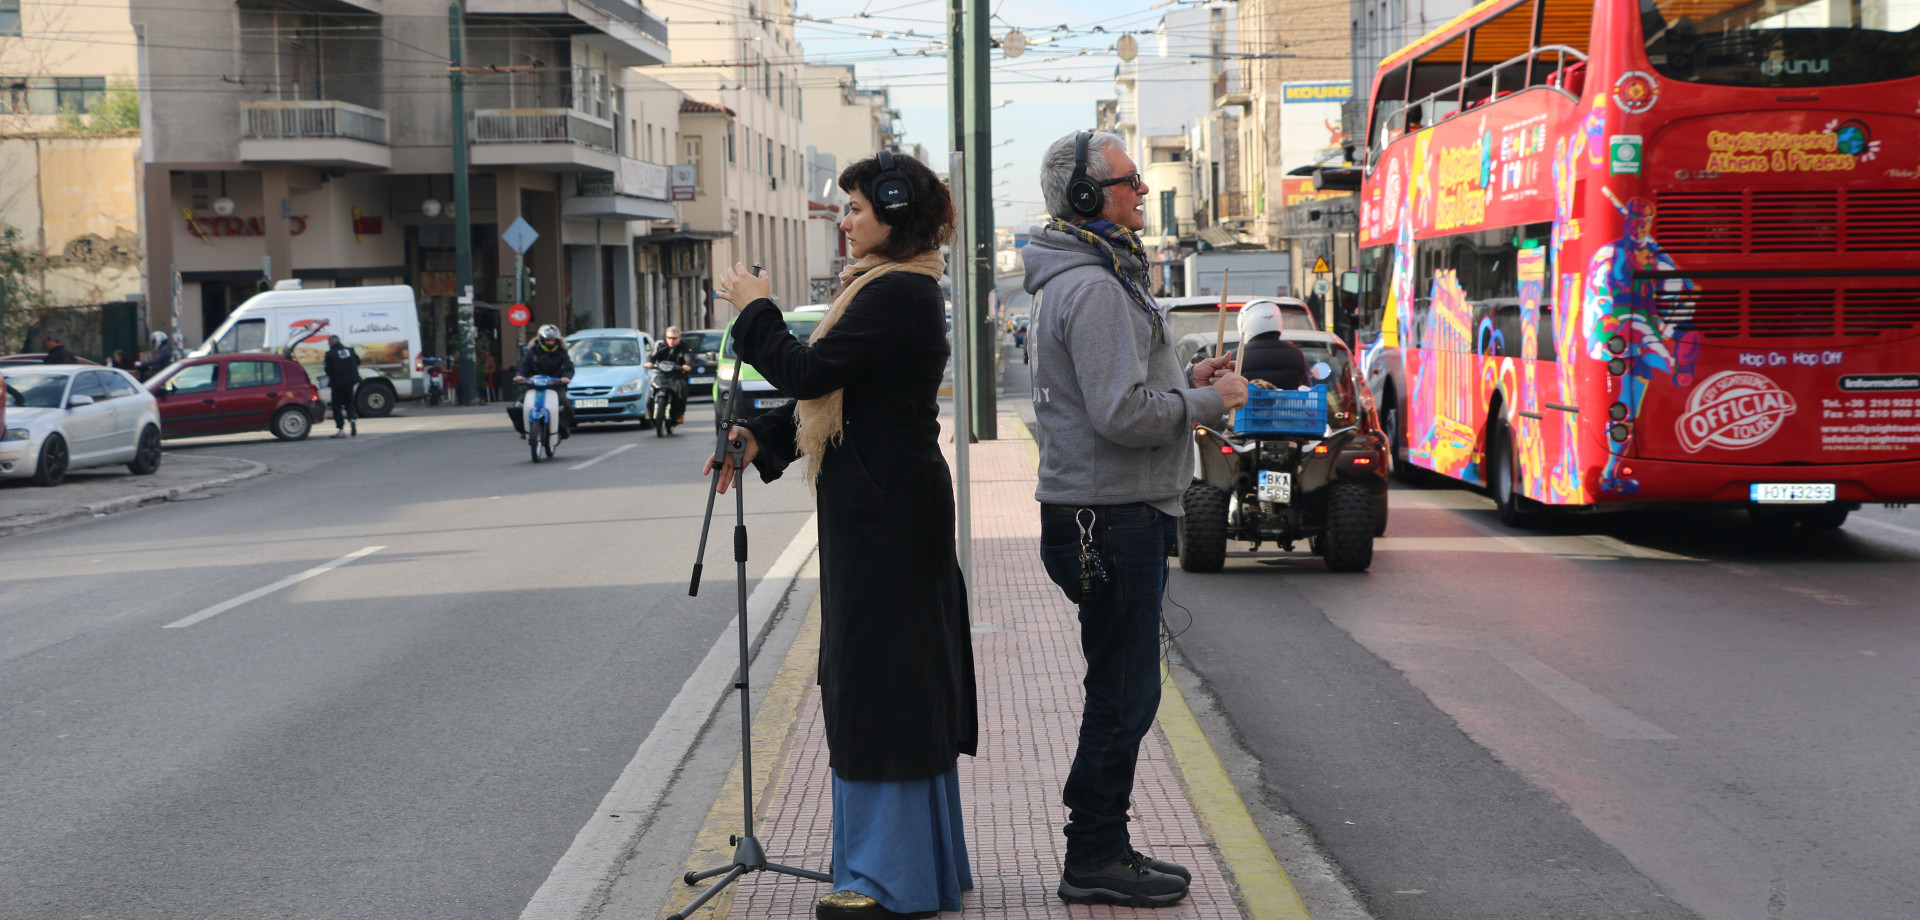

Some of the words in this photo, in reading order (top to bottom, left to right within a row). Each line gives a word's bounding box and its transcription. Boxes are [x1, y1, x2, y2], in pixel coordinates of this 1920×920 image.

[1706, 151, 1768, 172] Athens
[1770, 150, 1786, 172] &
[1786, 149, 1855, 171] Piraeus
[1738, 352, 1765, 367] Hop
[1767, 351, 1786, 366] On
[1791, 352, 1818, 367] Hop
[1820, 350, 1843, 365] Off
[1845, 378, 1918, 388] Information
[1690, 393, 1790, 437] OFFICIAL
[1733, 417, 1773, 438] TOUR
[1266, 488, 1289, 500] 565
